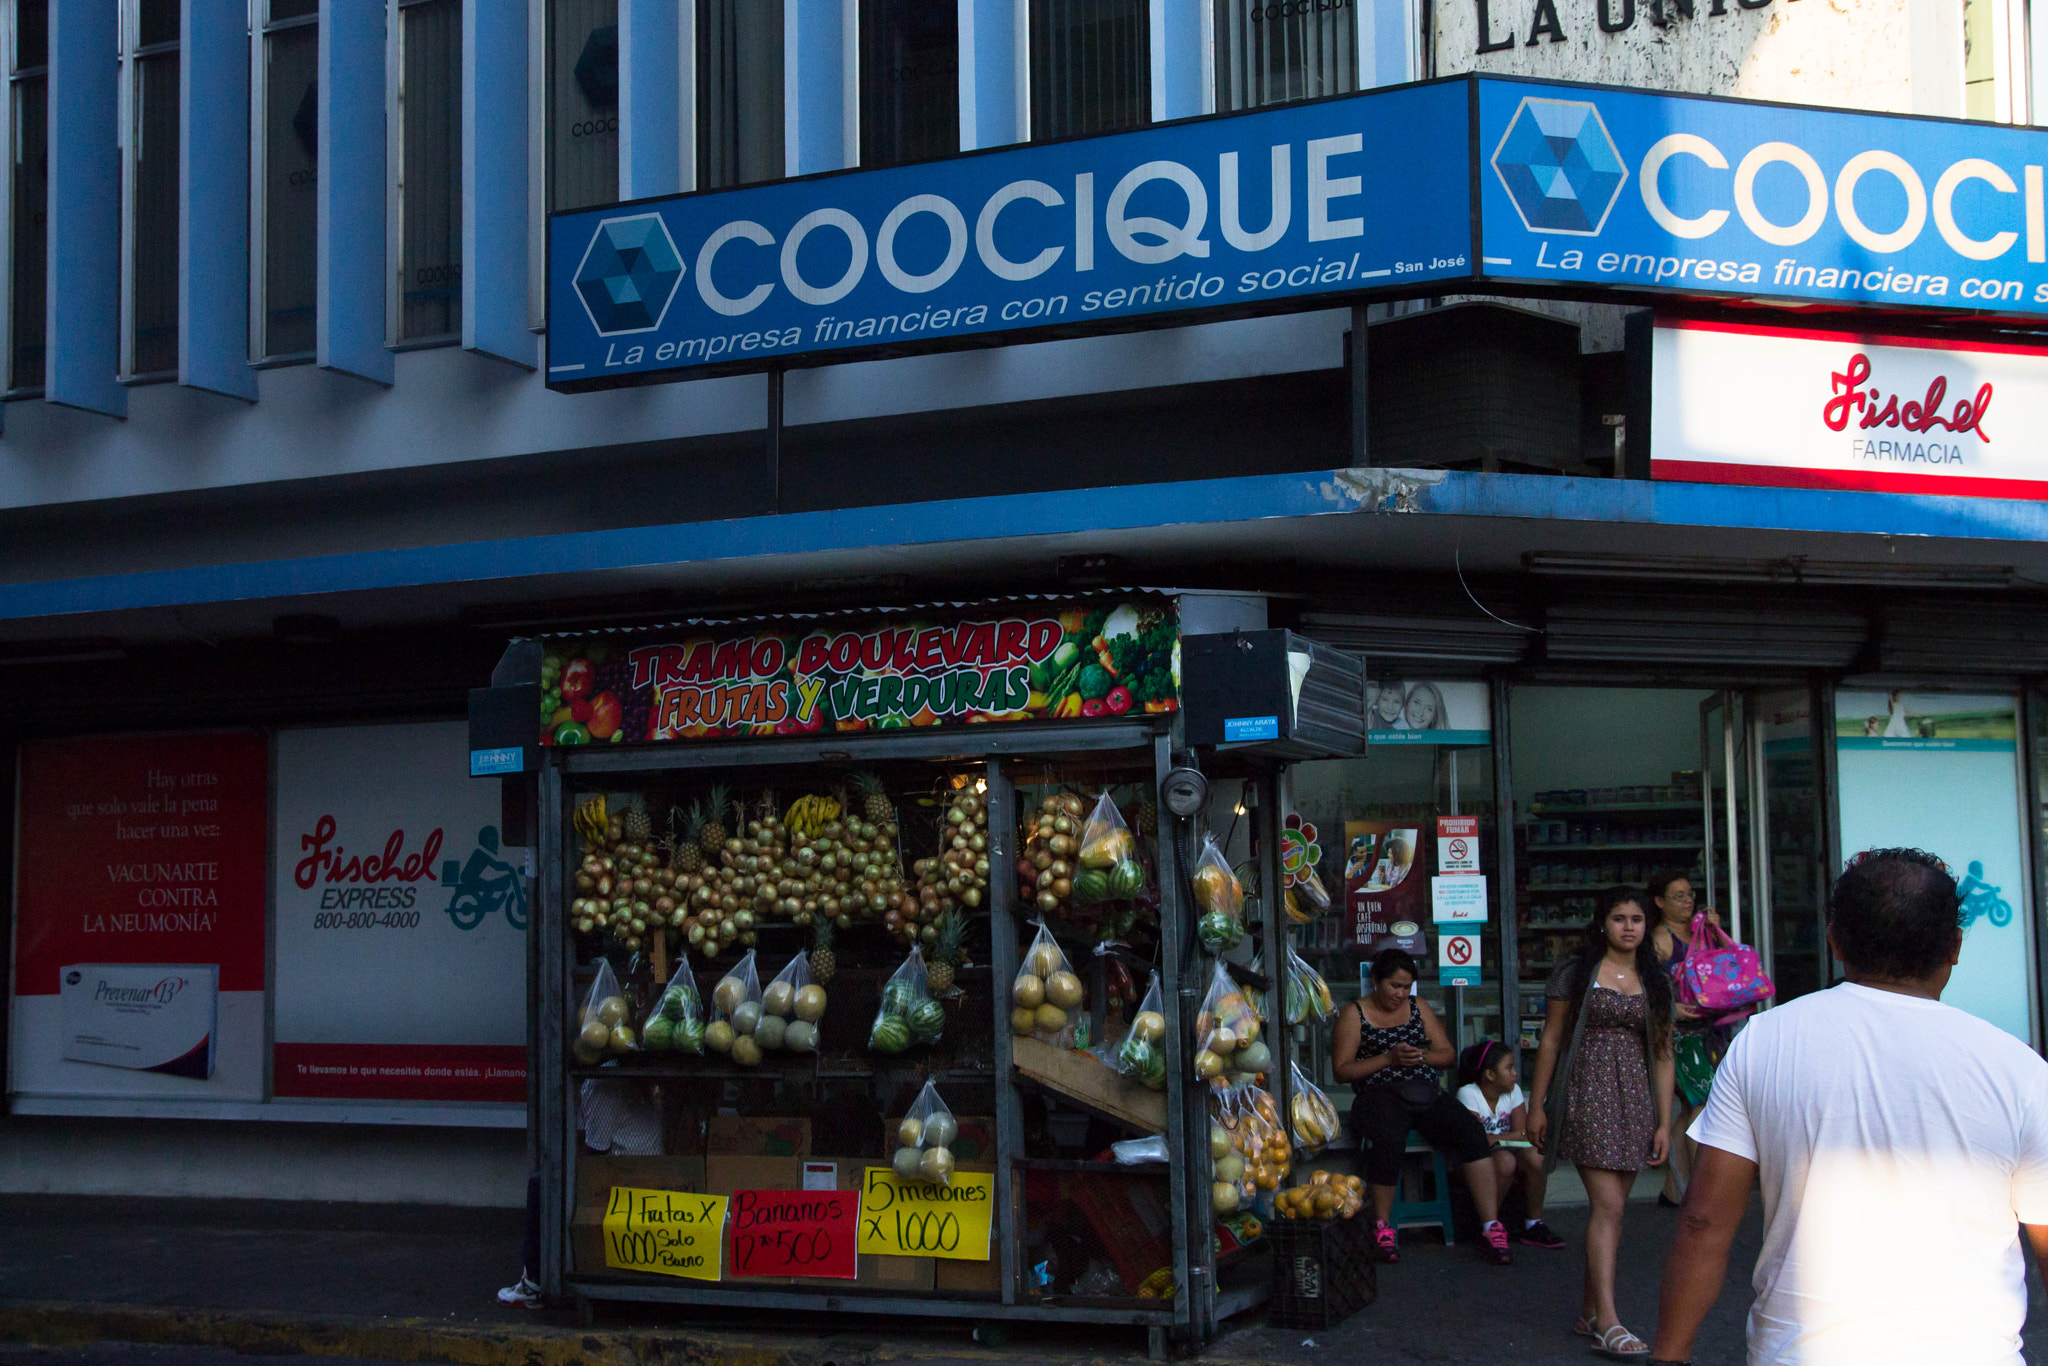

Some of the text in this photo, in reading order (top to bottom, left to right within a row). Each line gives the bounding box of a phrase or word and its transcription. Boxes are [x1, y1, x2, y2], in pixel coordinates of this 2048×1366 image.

[1639, 133, 2047, 263] COOCI
[695, 132, 1364, 316] COOCIQUE
[1394, 253, 1465, 274] San José
[1536, 241, 1583, 271] La
[1596, 253, 1760, 283] empresa
[1773, 258, 1949, 297] financiera
[1960, 277, 2024, 302] con
[604, 252, 1361, 368] La empresa financiera con sentido social
[1823, 353, 1993, 444] Fischel
[1852, 439, 1964, 465] FARMACIA
[628, 617, 1065, 690] TRAMO BOULEVARD
[657, 665, 1031, 733] FRUTAS Y VERDURAS
[147, 769, 219, 792] Hay otras
[66, 793, 218, 820] que solo vale la pena
[116, 820, 157, 840] hacer
[160, 824, 189, 838] una
[295, 814, 444, 889] Fischel
[107, 862, 219, 882] VACUNARTE
[138, 888, 219, 907] CONTRA
[320, 886, 417, 909] EXPRESS
[83, 914, 106, 933] LA
[314, 911, 420, 929] 800-800-4000
[94, 980, 155, 1001] Prevenar
[297, 1064, 307, 1075] Te
[309, 1064, 347, 1075] llevamos
[349, 1065, 358, 1075] lo
[360, 1067, 377, 1077] que
[424, 1066, 453, 1077] donde
[866, 1170, 987, 1212] 5 melones
[611, 1188, 632, 1232] 4
[736, 1190, 843, 1229] Bananos
[657, 1228, 695, 1247] Solo
[777, 1227, 832, 1265] 500
